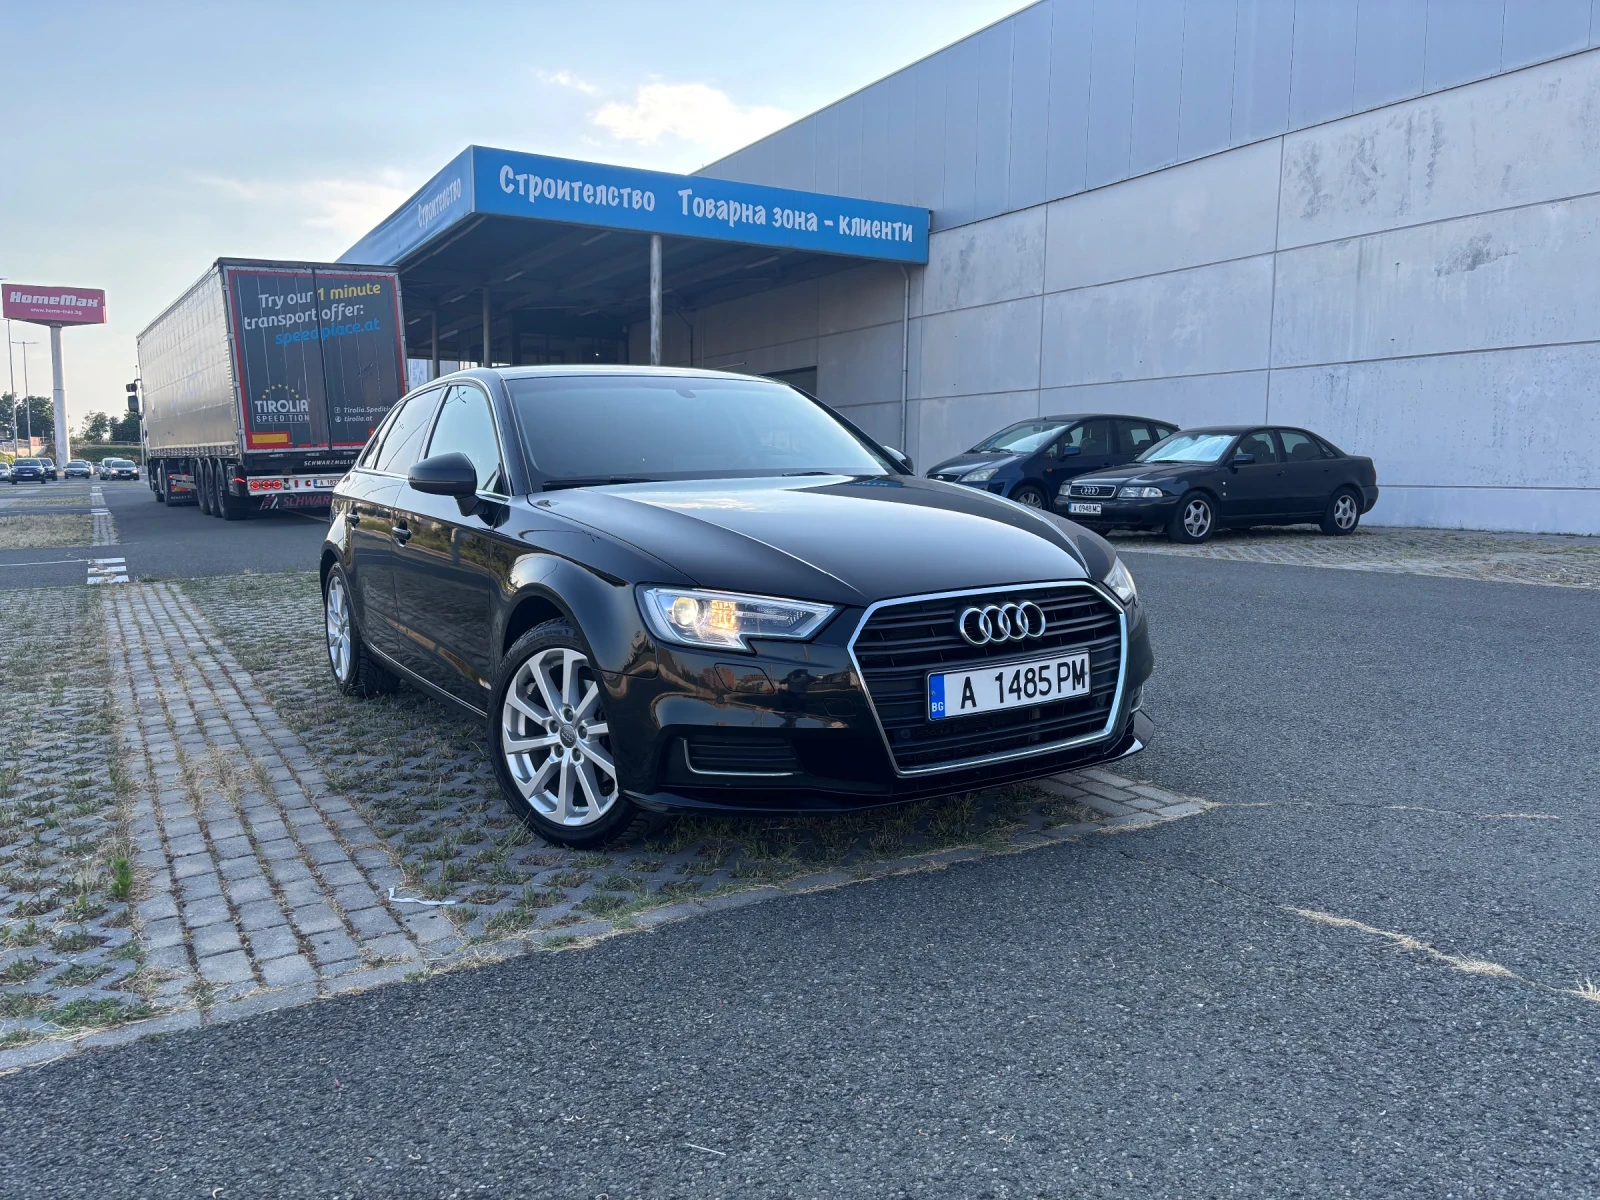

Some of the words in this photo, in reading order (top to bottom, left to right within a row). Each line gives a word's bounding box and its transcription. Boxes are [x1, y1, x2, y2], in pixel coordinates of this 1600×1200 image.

[500, 165, 656, 212] Строителство
[417, 178, 462, 228] Строителство
[678, 189, 766, 227] Товарна
[772, 207, 818, 231] зона
[839, 215, 913, 242] клиенти
[10, 292, 98, 307] HomeMax
[258, 294, 284, 309] Try
[287, 291, 313, 305] our
[318, 288, 325, 301] 1
[330, 283, 381, 299] minute
[31, 308, 82, 316] www.home-max.bg
[244, 308, 317, 330] transport
[321, 303, 364, 321] offer:
[275, 318, 380, 346] speedplace.at
[255, 400, 309, 413] TIROLIA
[931, 701, 944, 712] BG
[960, 676, 977, 709] A
